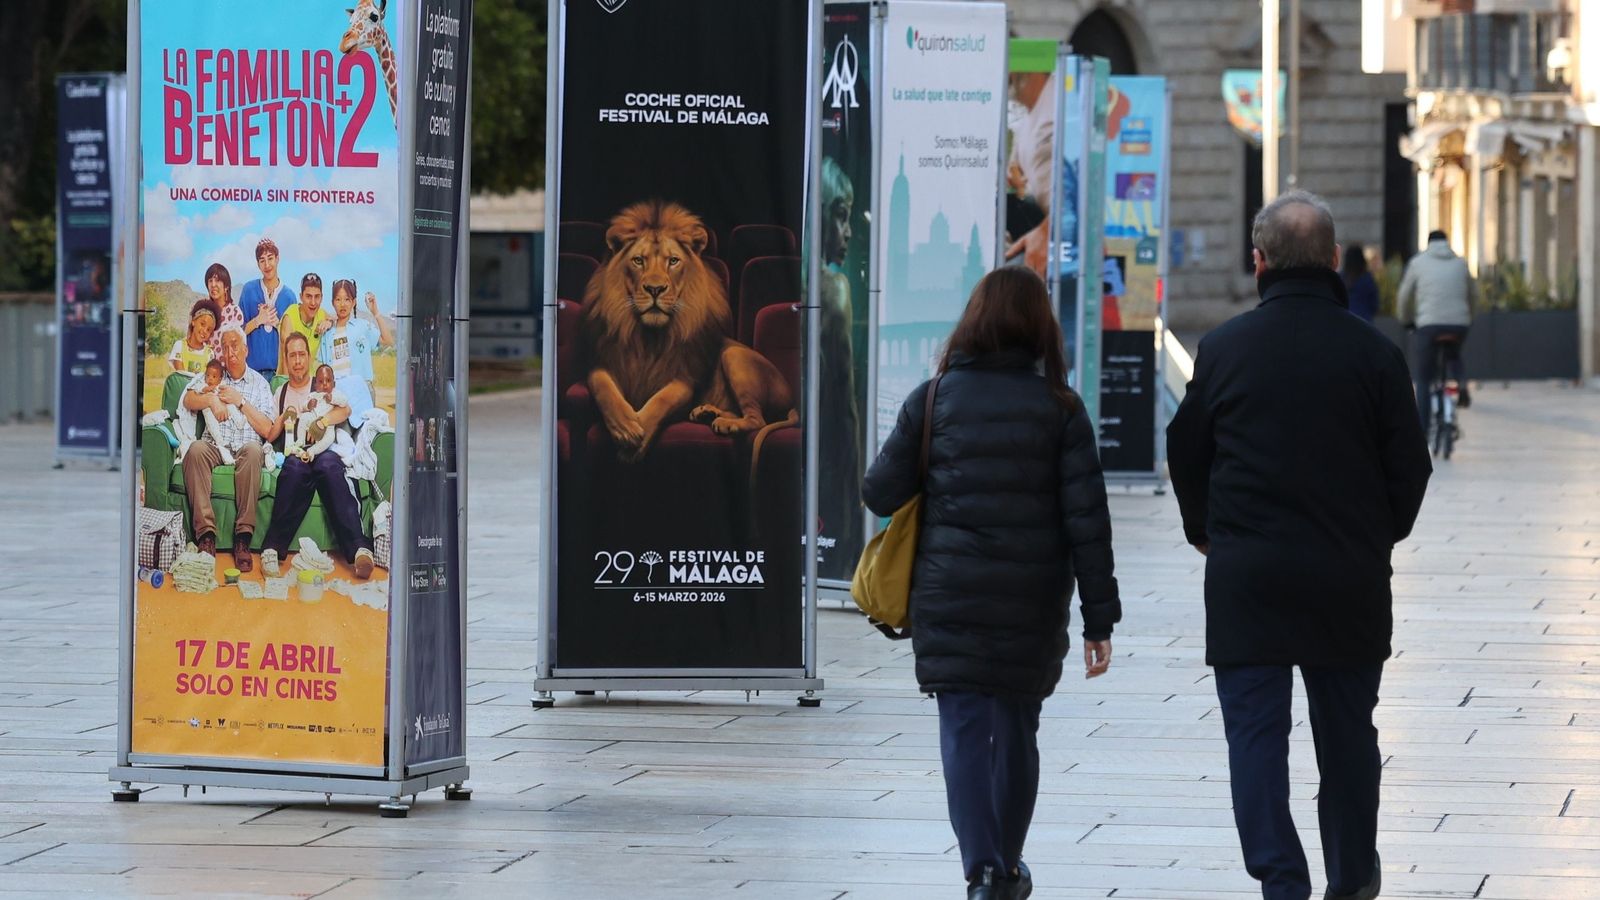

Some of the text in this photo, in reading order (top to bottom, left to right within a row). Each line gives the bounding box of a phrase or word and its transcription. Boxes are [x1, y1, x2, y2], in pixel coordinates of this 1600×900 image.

[163, 49, 334, 113] LA FAMILIA
[424, 72, 433, 100] de
[624, 93, 745, 108] COCHE OFICIAL
[892, 88, 902, 101] La
[904, 88, 926, 101] salud
[927, 90, 944, 104] que
[961, 89, 992, 104] contigo
[163, 84, 335, 167] BENETÓN
[599, 109, 770, 125] FESTIVAL DE MÁLAGA
[918, 156, 942, 168] somos
[170, 188, 375, 204] UNA COMEDIA SIN FRONTERAS
[669, 550, 765, 563] FESTIVAL DE
[594, 551, 635, 583] 29
[669, 562, 765, 584] MÁLAGA
[633, 591, 726, 602] 6-15 MARZO 2026
[175, 640, 341, 674] 17 DE ABRIL
[176, 673, 337, 701] SOLO EN CINES
